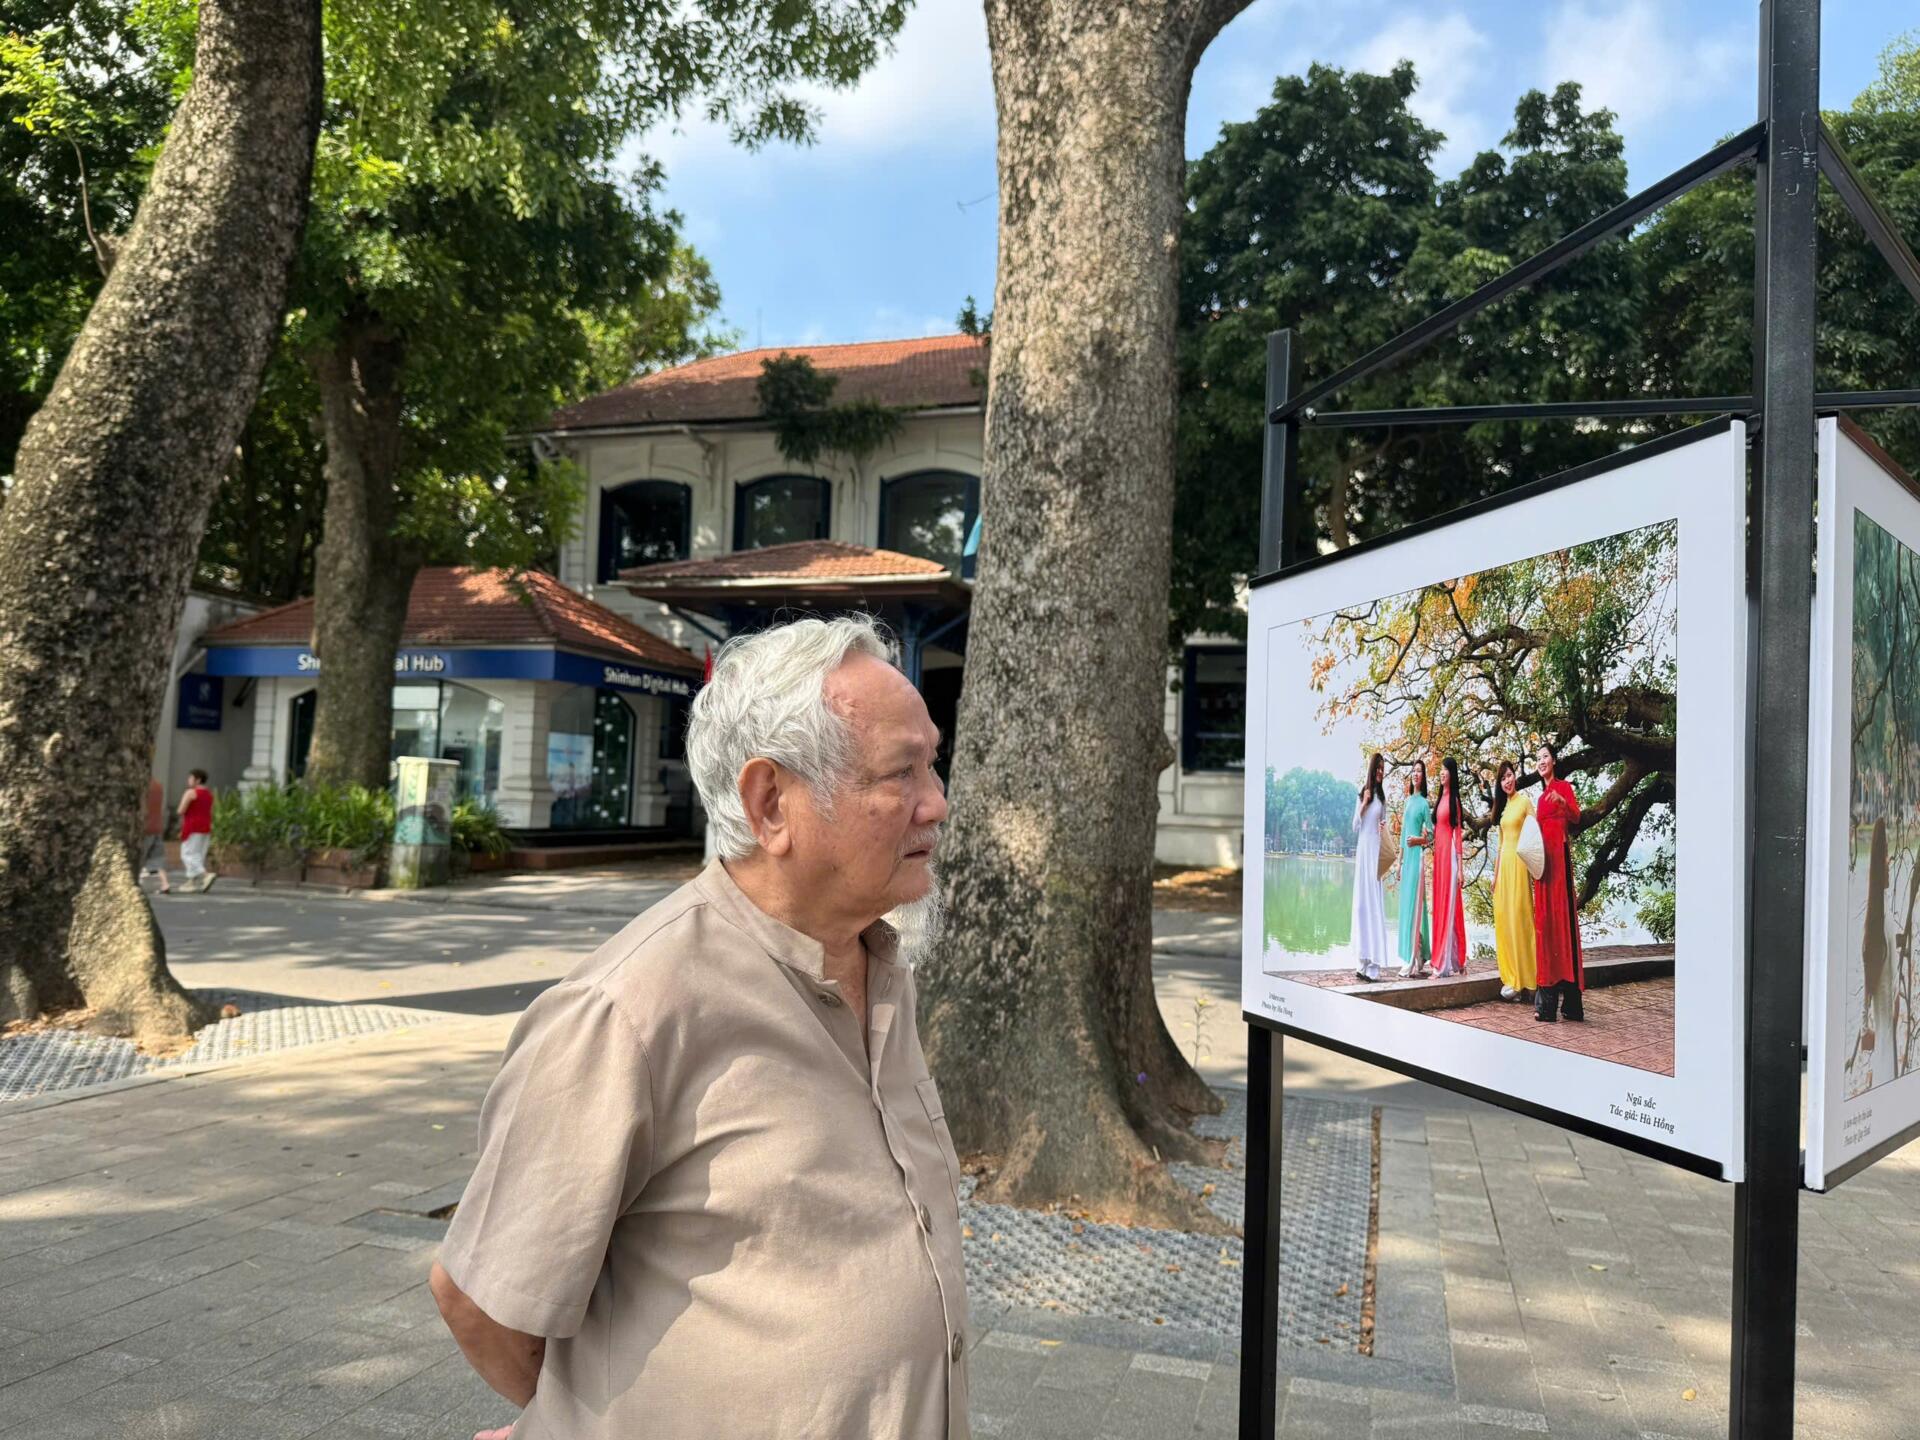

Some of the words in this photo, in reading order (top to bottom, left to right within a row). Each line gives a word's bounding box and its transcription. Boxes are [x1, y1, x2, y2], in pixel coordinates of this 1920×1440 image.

[412, 654, 445, 672] Hub
[604, 666, 642, 687] Shinhan
[642, 673, 671, 695] Digital
[671, 679, 689, 696] Hub
[1626, 1091, 1642, 1107] Ngũ
[1643, 1096, 1657, 1110] sắc
[1609, 1103, 1624, 1116] Tác
[1640, 1112, 1651, 1125] Hà
[1653, 1116, 1675, 1134] Hồng
